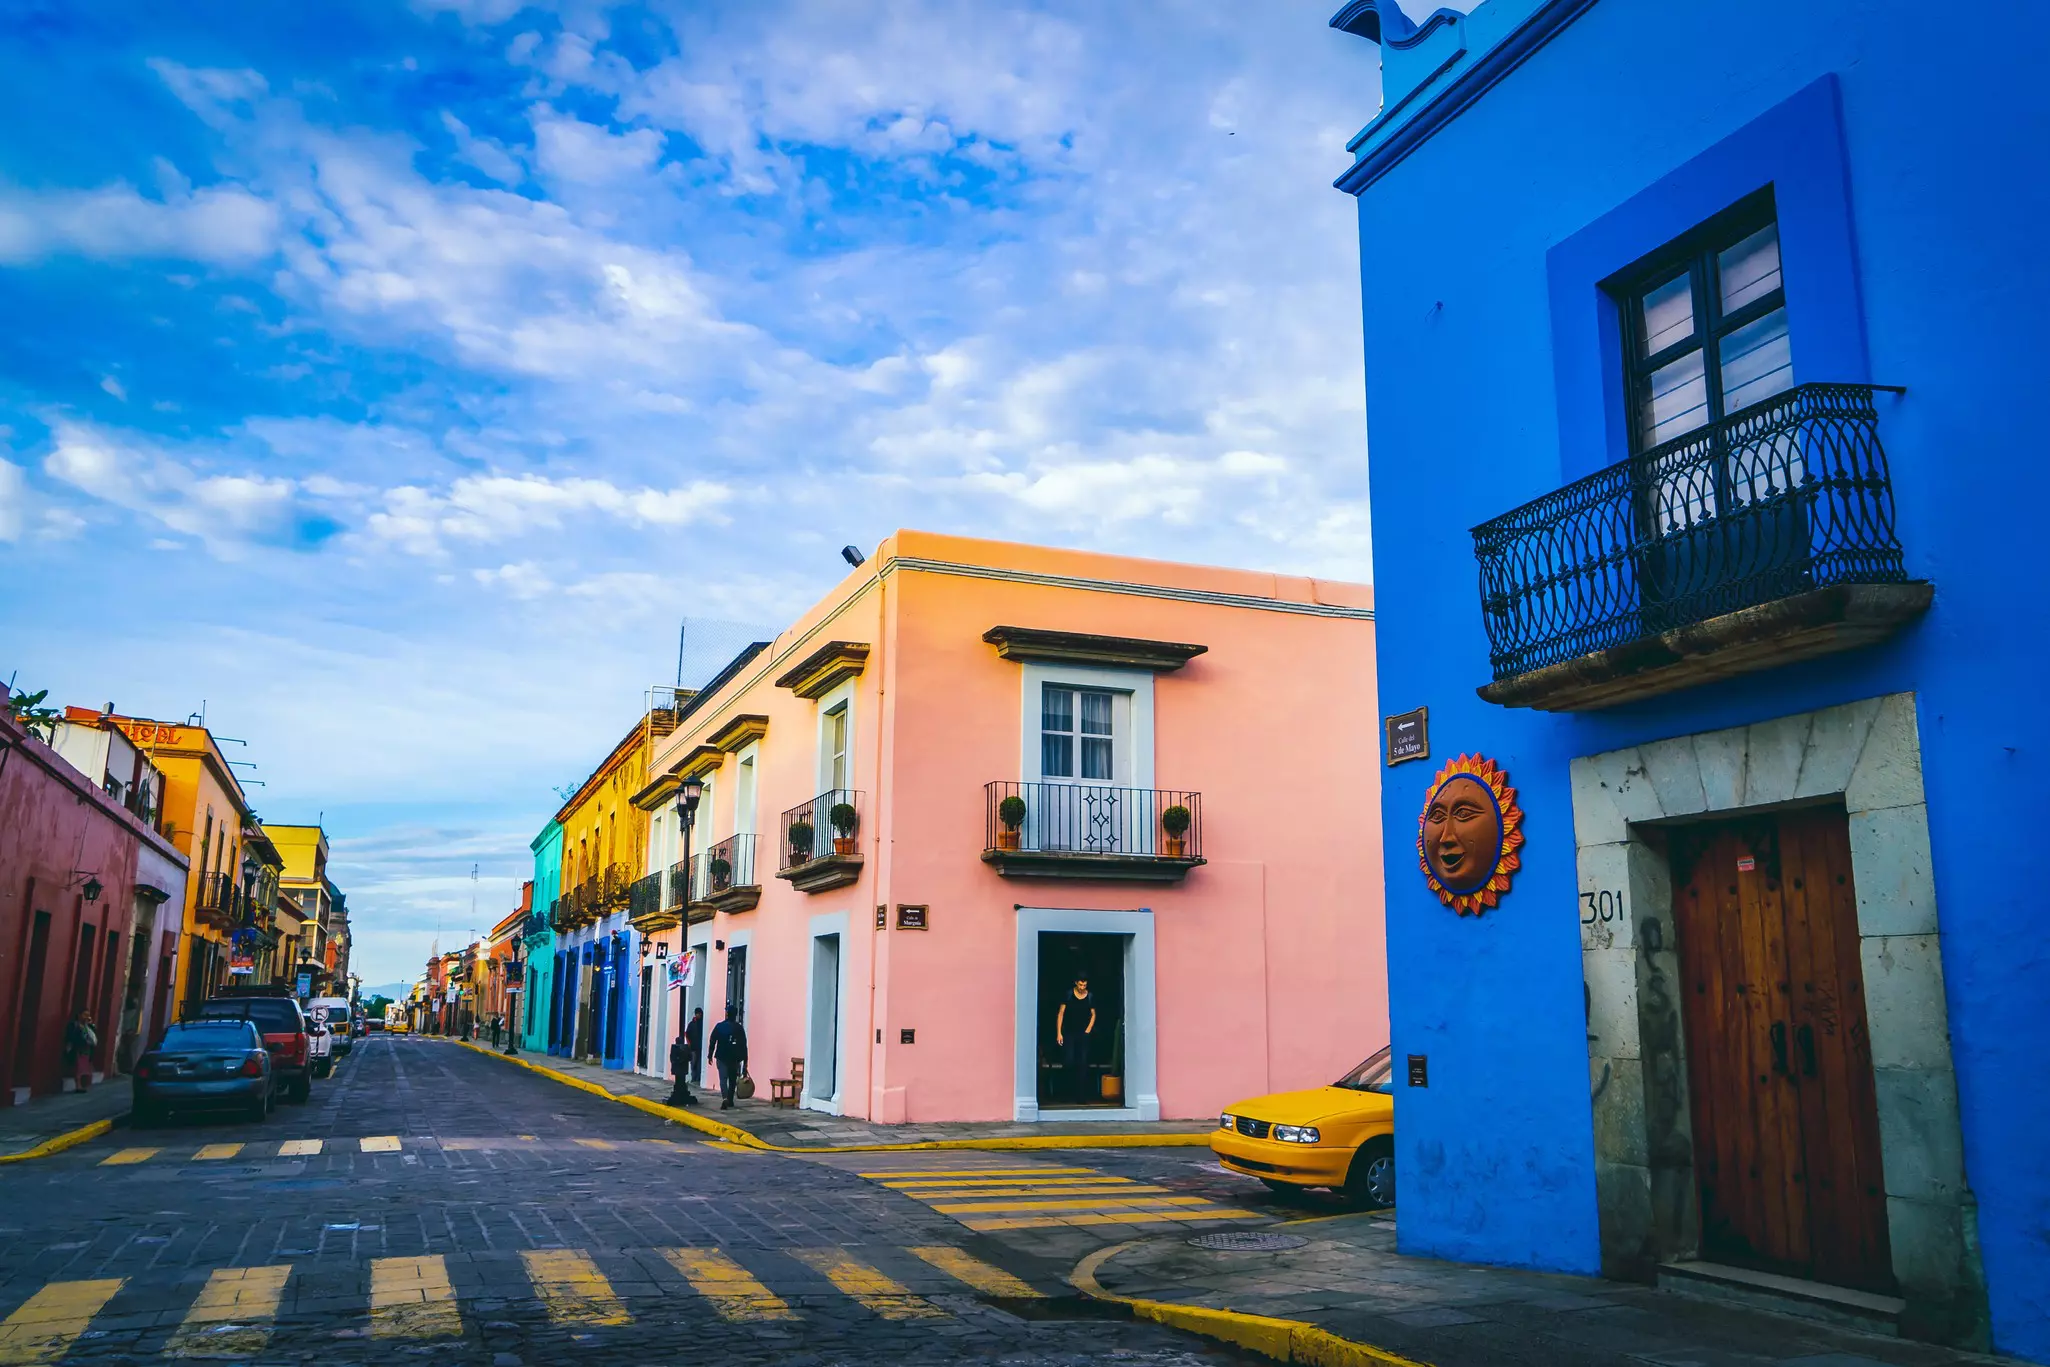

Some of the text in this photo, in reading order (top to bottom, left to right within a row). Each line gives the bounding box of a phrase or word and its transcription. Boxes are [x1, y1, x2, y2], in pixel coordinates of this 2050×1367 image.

[1398, 736, 1408, 745] Calle
[1393, 743, 1420, 756] 5 de Mayo
[1580, 890, 1623, 924] 301
[657, 945, 666, 957] H
